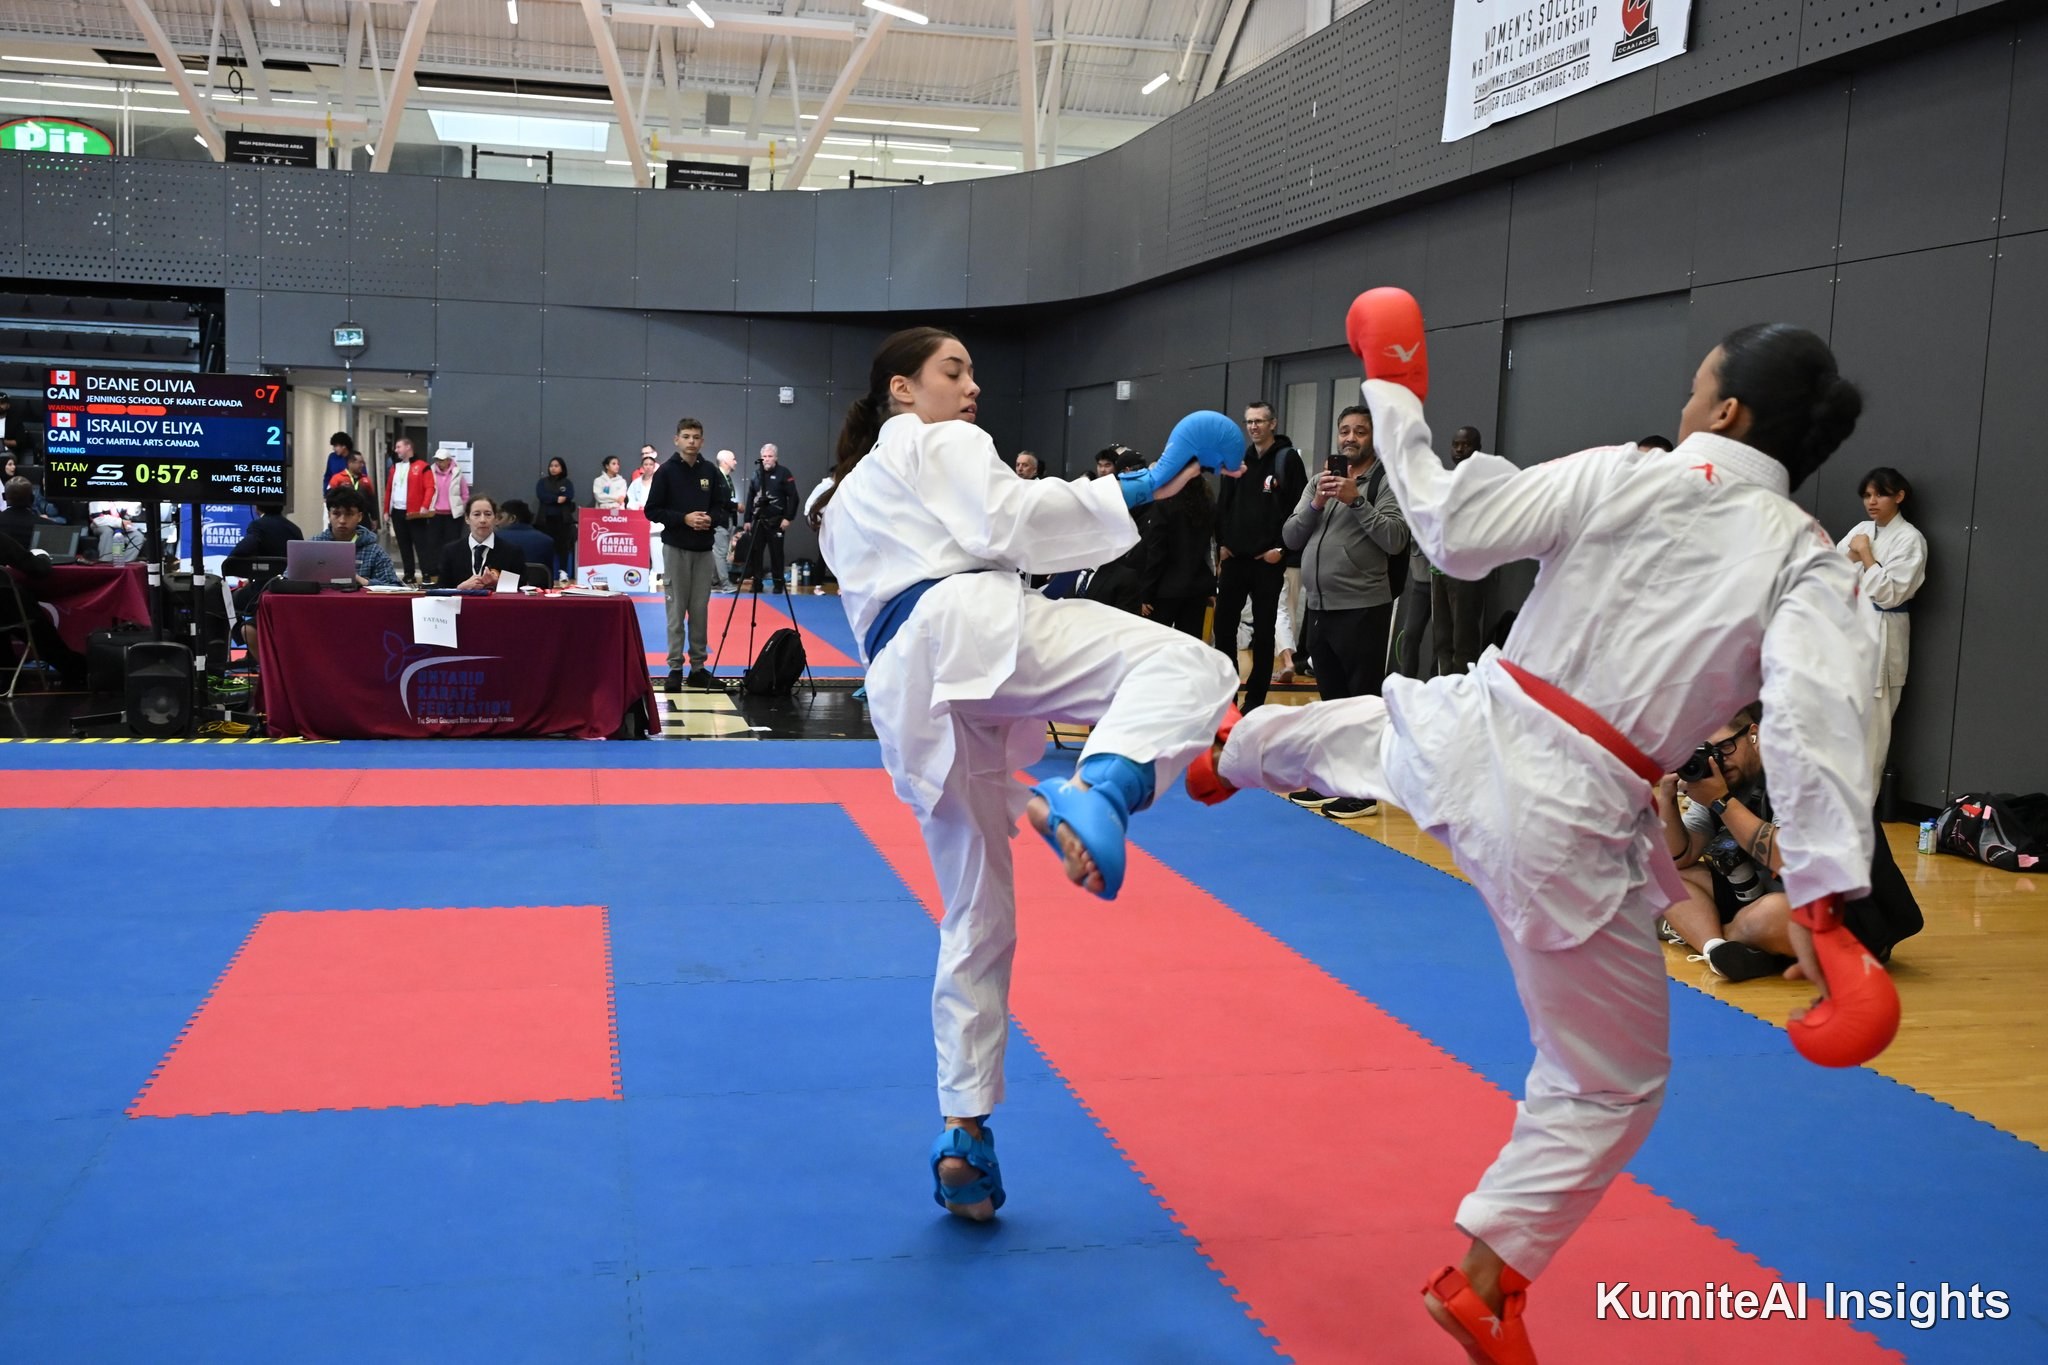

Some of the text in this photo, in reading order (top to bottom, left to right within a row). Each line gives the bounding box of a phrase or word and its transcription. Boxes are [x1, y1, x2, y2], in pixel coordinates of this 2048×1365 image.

[1485, 9, 1533, 52] WOMEN'S
[1472, 6, 1597, 79] NATONAL CHAMPIONSHIP
[1543, 48, 1565, 70] SOCCER
[1502, 86, 1526, 107] COLLEGE
[1532, 70, 1566, 96] CAMBRIDGE
[14, 125, 88, 154] Pit
[252, 141, 289, 149] PERFORMANCE
[86, 376, 196, 393] DEANE OLIVIA
[47, 387, 80, 400] CAN
[85, 395, 243, 408] JENNINGS SCHOOL OF KARATE CANADA
[48, 404, 85, 412] WARNING
[86, 418, 204, 436] ISRAILOV ELIYA
[47, 430, 81, 442] CAN
[266, 425, 281, 445] 2
[86, 437, 200, 448] KOC MARTIAL ARTS CANADA
[48, 446, 86, 454] WARNING
[234, 464, 282, 473] 162. FEMALE
[70, 477, 78, 488] 2
[211, 474, 241, 482] KUMITE
[248, 475, 265, 483] AGE
[266, 476, 282, 484] +18
[229, 485, 243, 493] -68
[244, 485, 256, 494] KG
[261, 486, 284, 494] FINAL
[205, 505, 234, 513] COACH
[206, 527, 242, 537] KARATE
[602, 537, 634, 546] KARATE
[602, 545, 638, 553] ONTARIO
[423, 616, 448, 625] TATAMI
